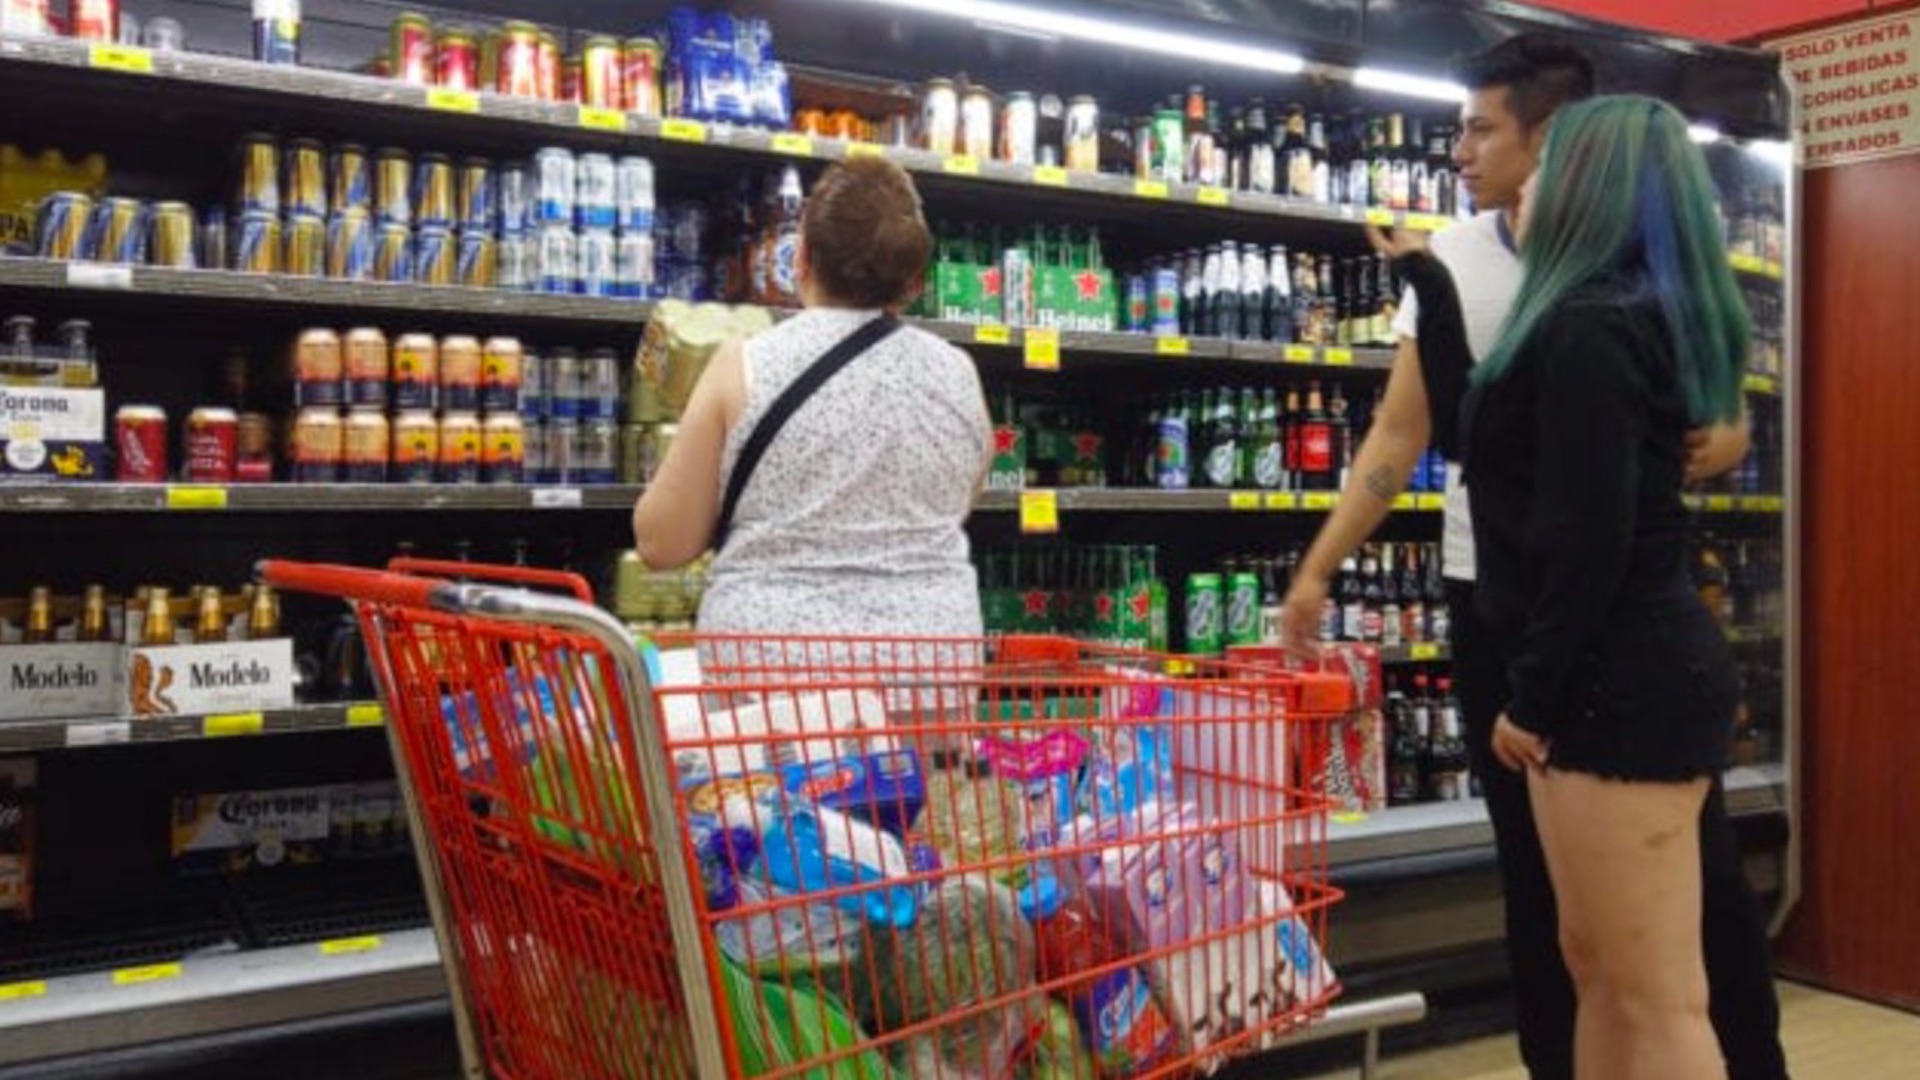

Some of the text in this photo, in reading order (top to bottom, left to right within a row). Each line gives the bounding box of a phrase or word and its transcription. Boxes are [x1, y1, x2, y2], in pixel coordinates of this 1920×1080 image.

[1785, 23, 1911, 62] SOLO VENTA
[1819, 51, 1907, 80] BEBIDAS
[1816, 102, 1910, 132] ENVASES
[0, 391, 68, 412] orona
[11, 662, 97, 691] Modelo
[190, 660, 270, 689] Modelo
[220, 794, 320, 825] Corona
